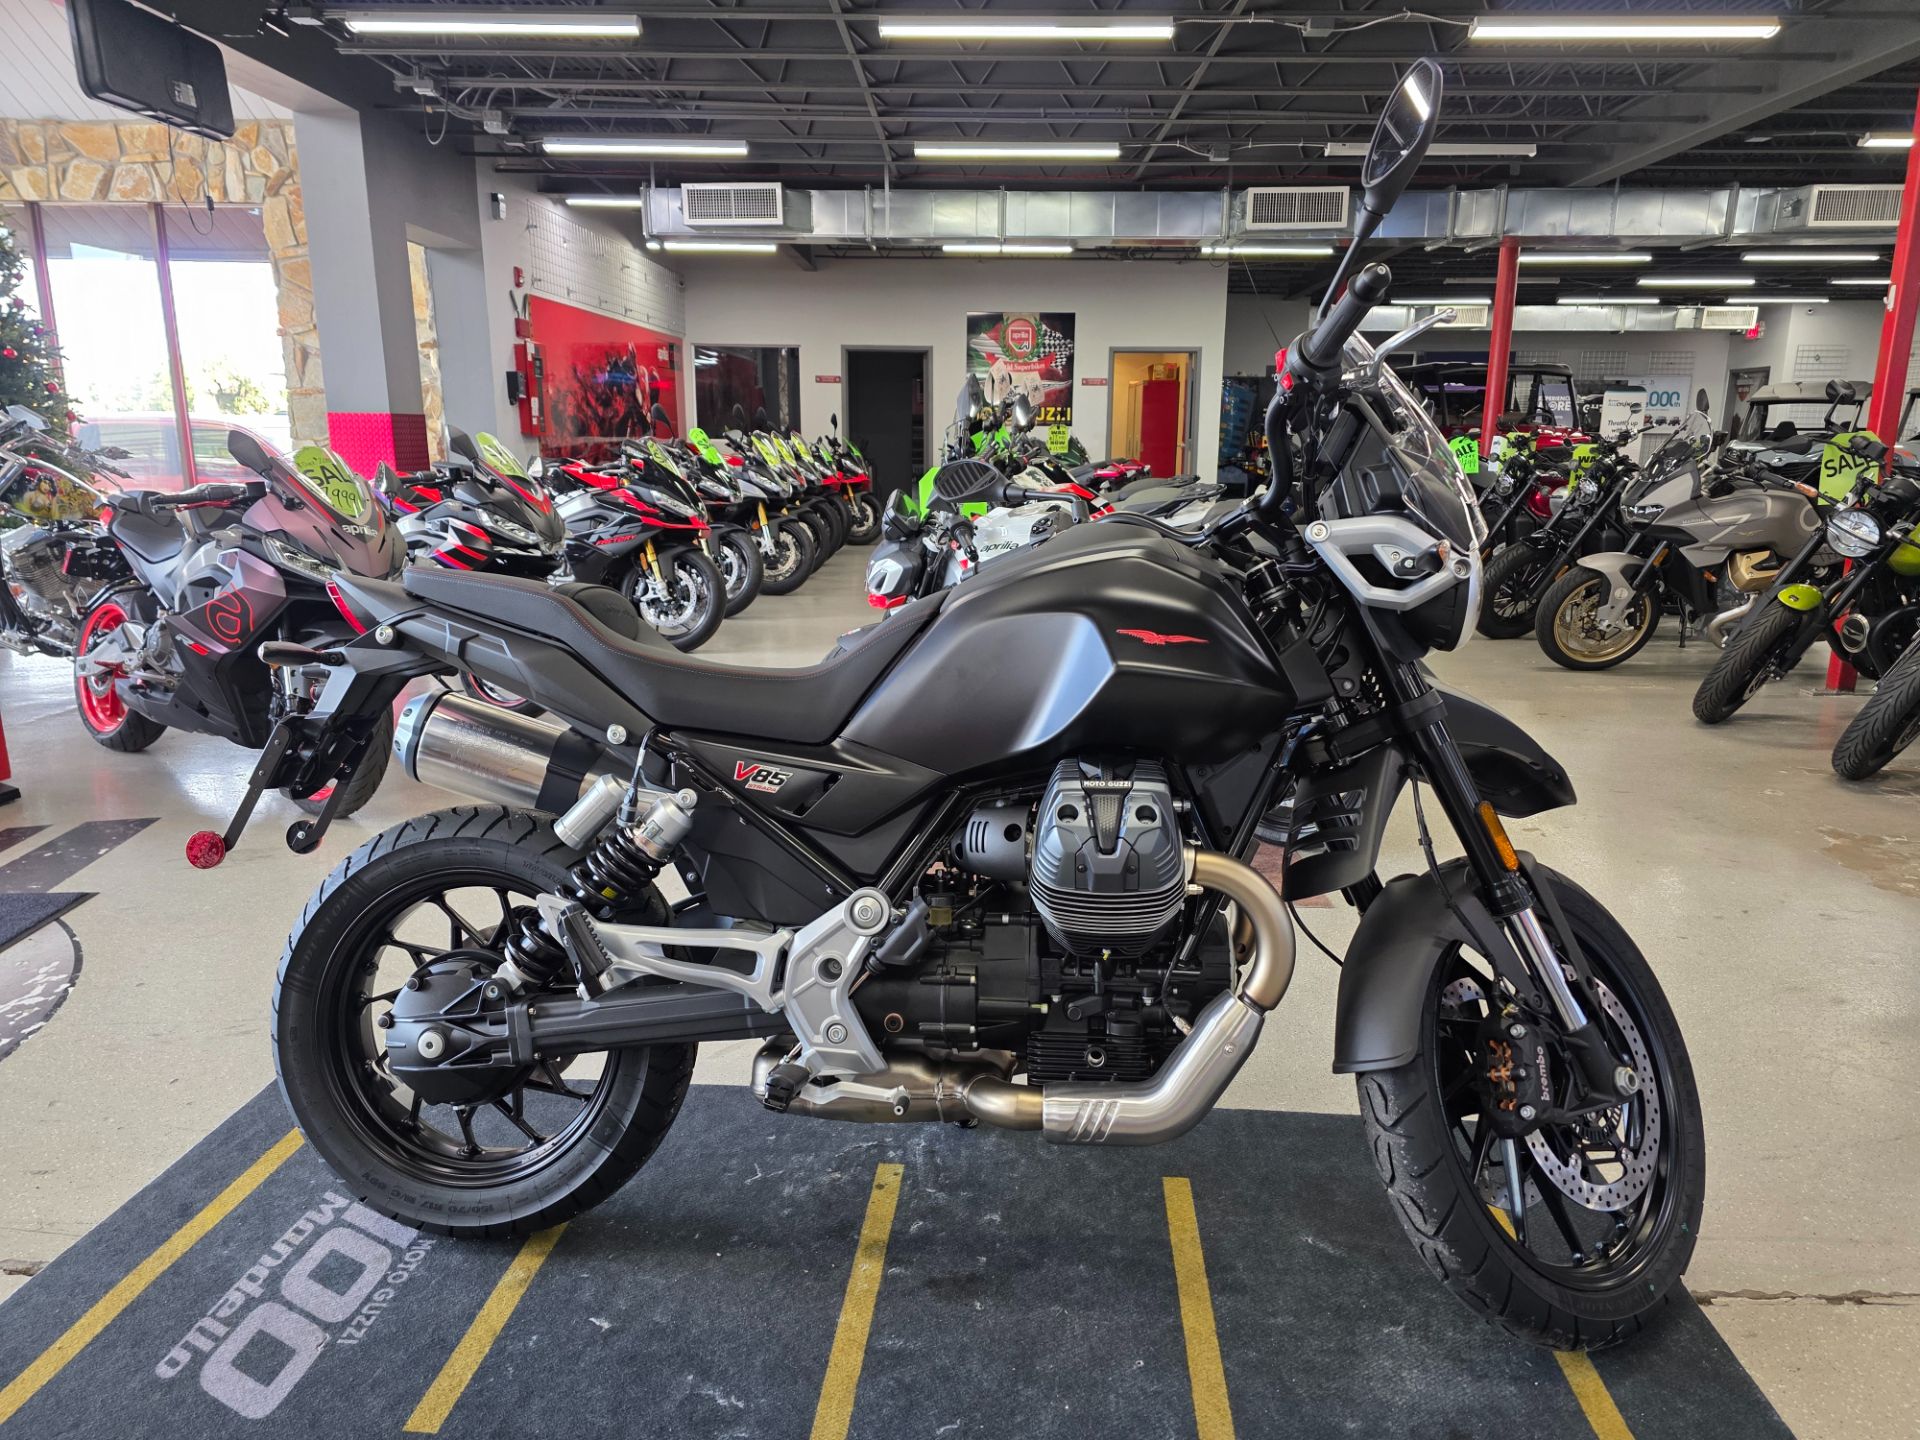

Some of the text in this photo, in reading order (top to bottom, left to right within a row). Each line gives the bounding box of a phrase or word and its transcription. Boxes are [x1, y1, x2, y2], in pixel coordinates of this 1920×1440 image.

[1456, 443, 1476, 458] ALE
[303, 463, 354, 487] SAL
[980, 540, 1019, 553] aprilia
[734, 760, 793, 786] V85
[1536, 1045, 1551, 1101] brembo
[155, 1190, 351, 1379] Mandello
[336, 1238, 437, 1345] MOTO GUZZI
